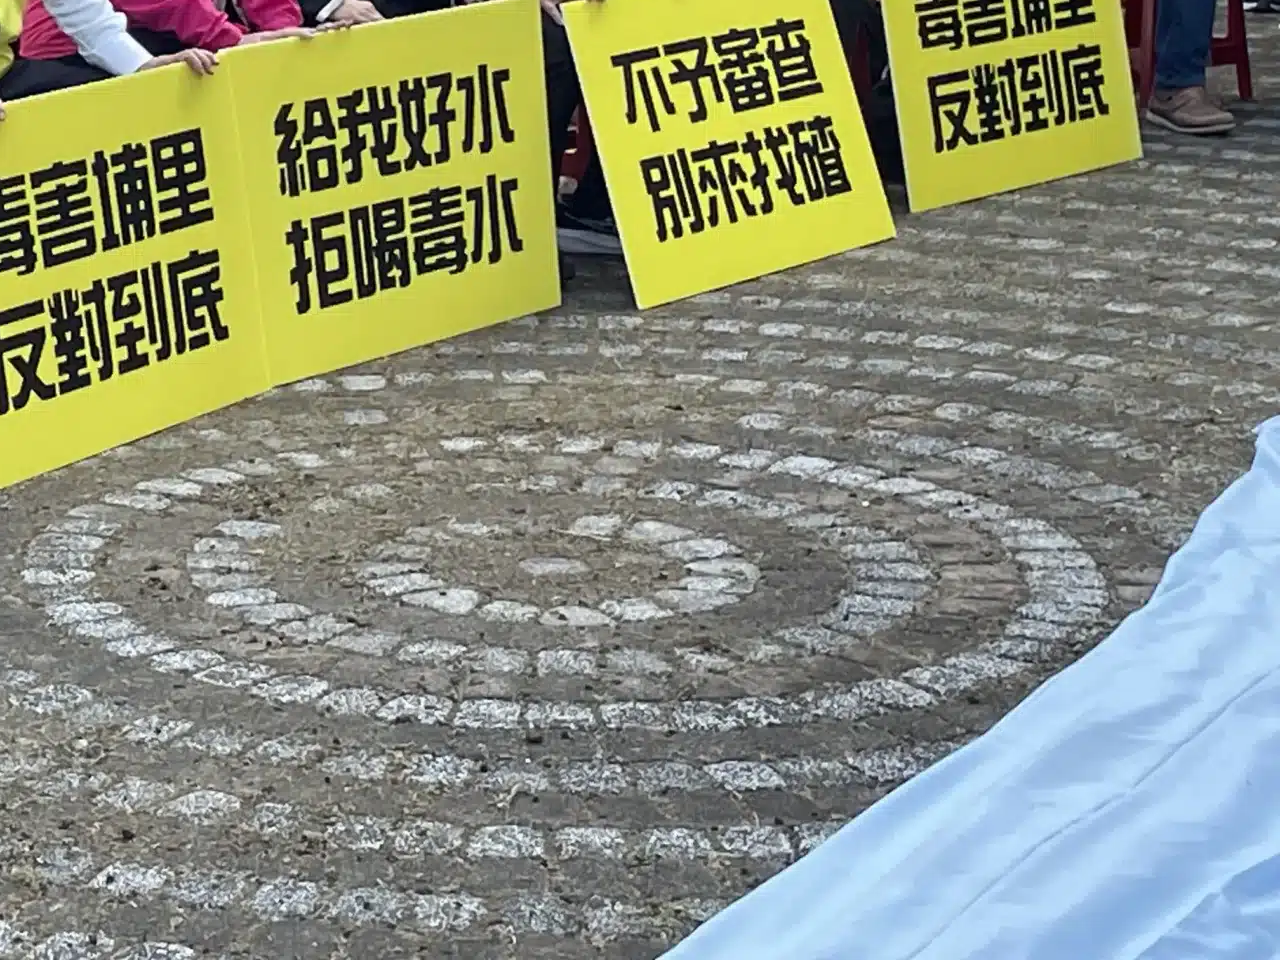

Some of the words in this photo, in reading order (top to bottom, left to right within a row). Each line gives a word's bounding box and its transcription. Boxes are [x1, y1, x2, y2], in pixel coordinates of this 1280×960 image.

[274, 64, 515, 197] 給我好水
[611, 18, 823, 132] 不予審查
[927, 44, 1109, 154] 反對到底
[639, 115, 853, 243] 別來找碴
[285, 174, 523, 315] 拒喝毒水
